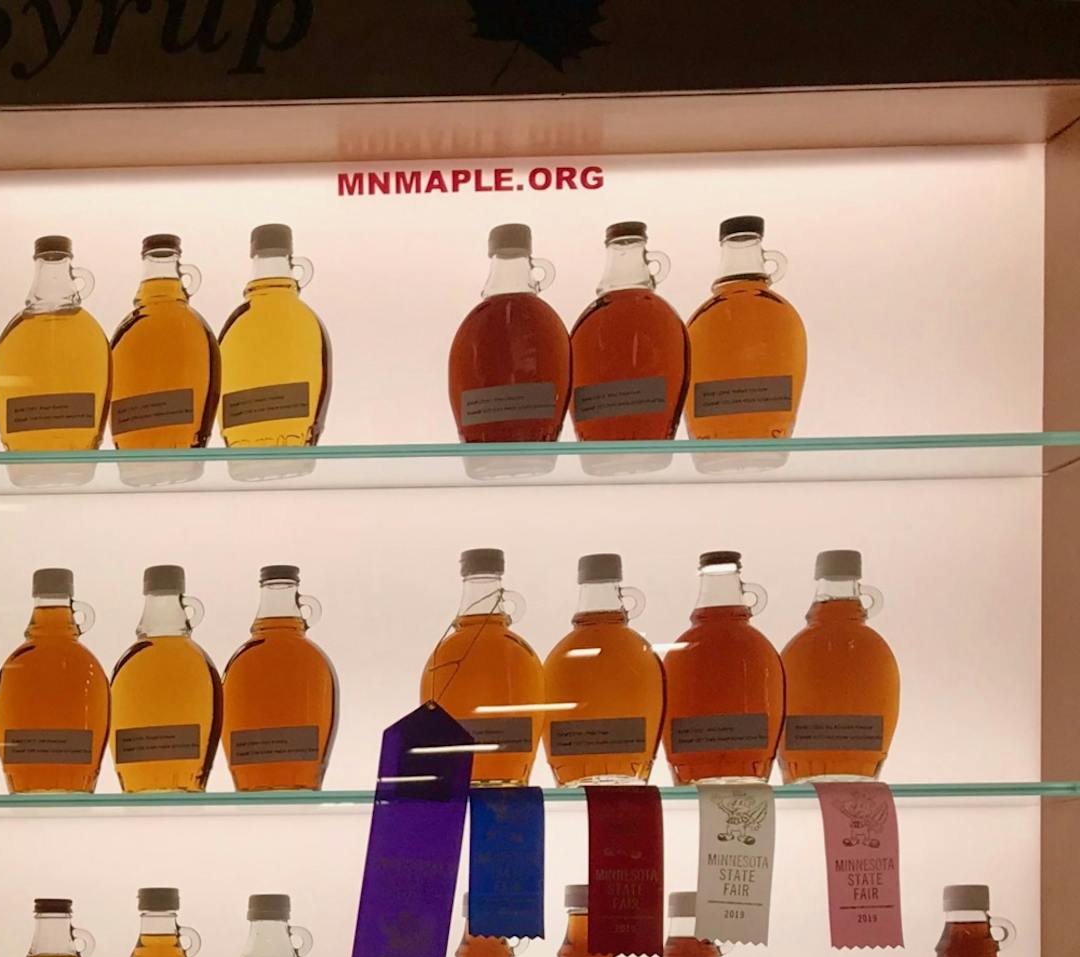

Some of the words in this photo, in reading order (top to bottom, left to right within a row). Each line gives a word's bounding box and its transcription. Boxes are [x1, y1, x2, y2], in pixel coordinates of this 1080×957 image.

[337, 166, 604, 196] MNMAPLE.ORG
[707, 853, 769, 869] MINNESOTA
[835, 857, 895, 872] MINNESOTA
[719, 868, 756, 882] STATE
[847, 872, 884, 886] STATE
[723, 884, 749, 897] FAIR
[853, 887, 879, 900] FAIR
[724, 910, 745, 919] 2019
[857, 913, 878, 923] 2019
